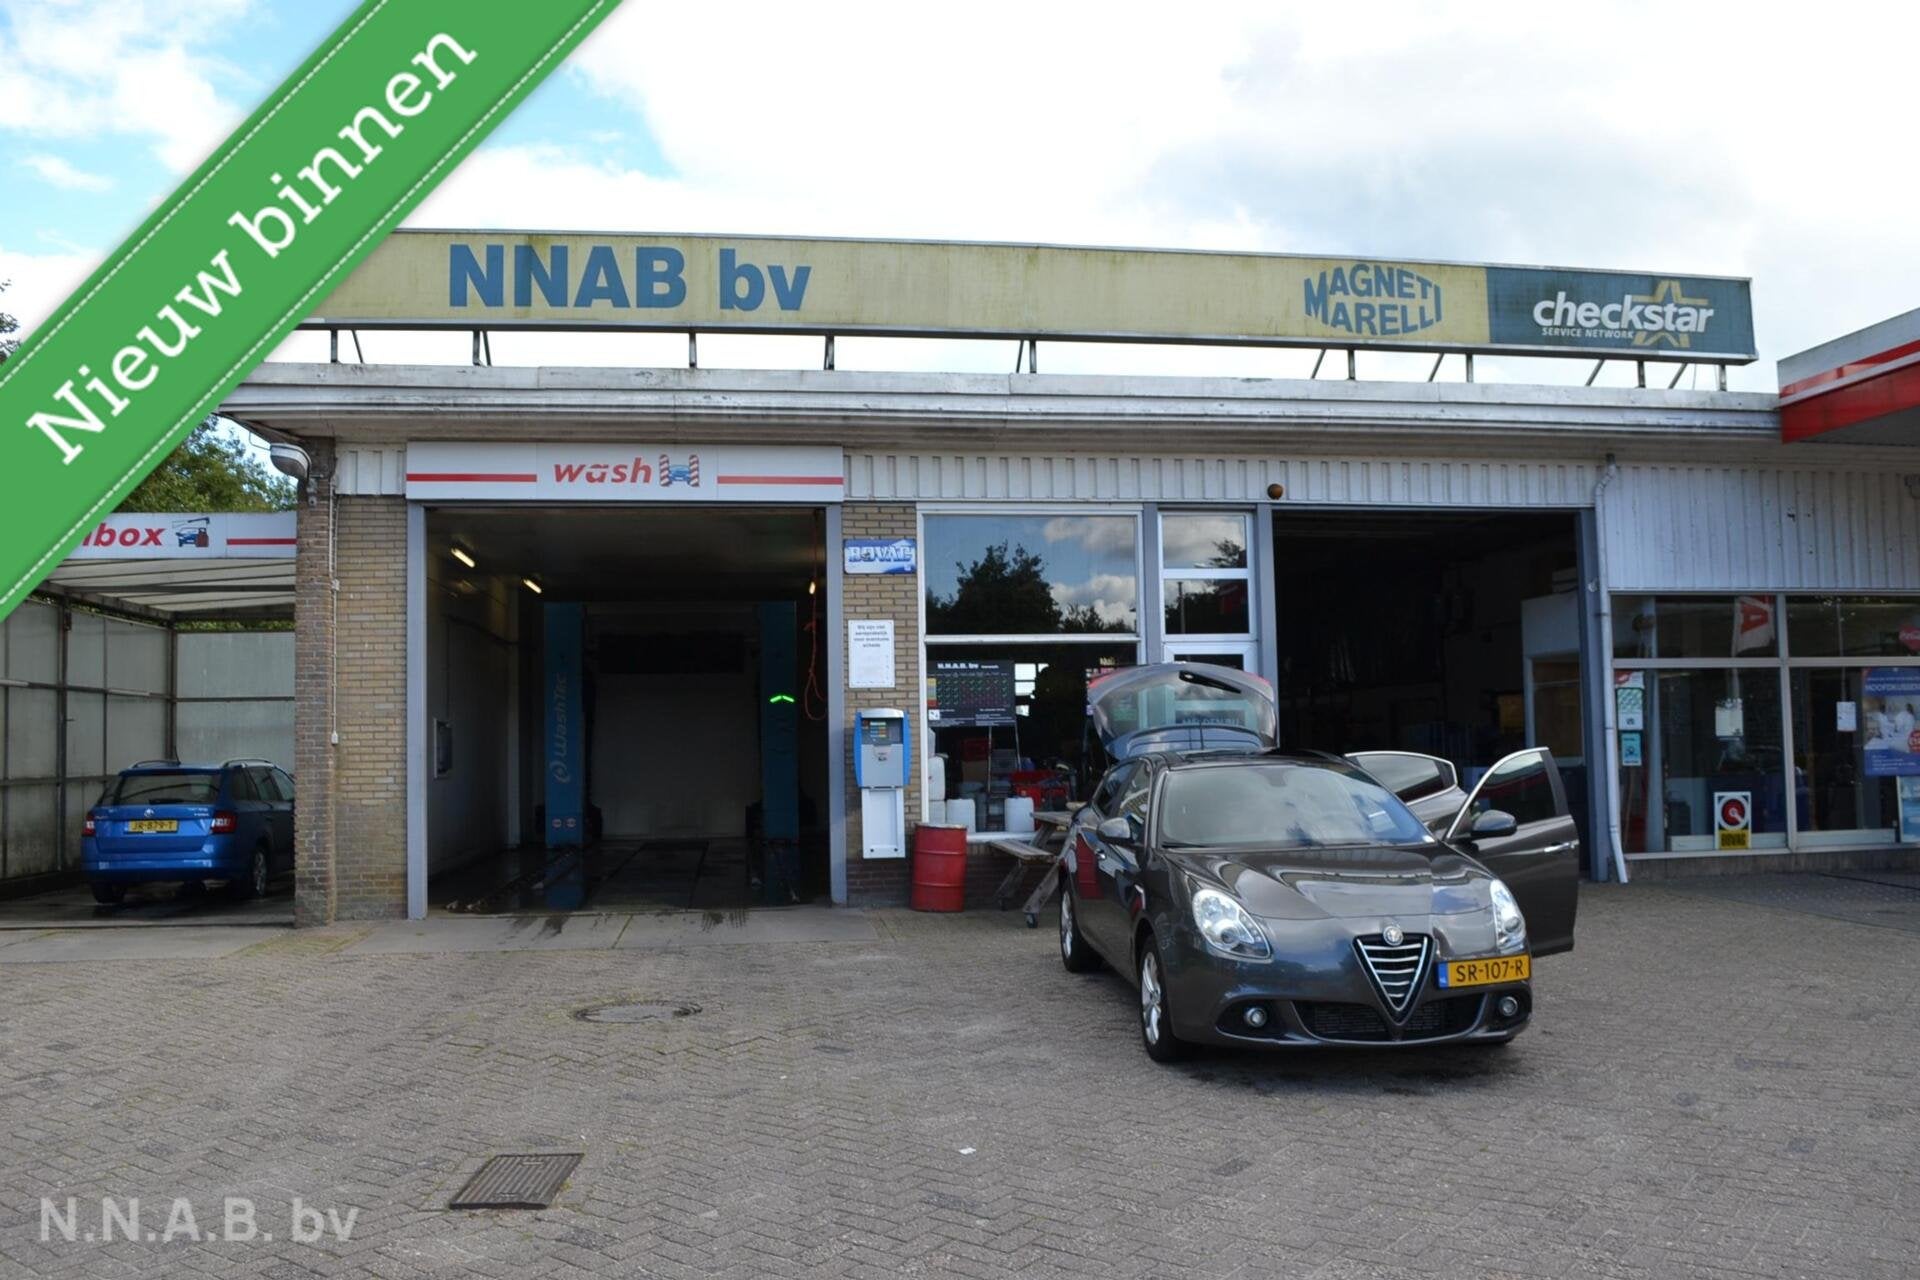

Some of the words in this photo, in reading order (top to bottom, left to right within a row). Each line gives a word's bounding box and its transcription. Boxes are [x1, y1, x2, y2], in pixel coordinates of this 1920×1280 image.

[450, 244, 687, 308] NNAB
[719, 248, 811, 311] bv
[1304, 264, 1442, 312] MAGNETI
[1533, 291, 1714, 332] checkstar
[1541, 327, 1582, 337] SERVICE
[1585, 329, 1634, 339] NETWORK
[554, 457, 652, 484] wash
[1456, 959, 1524, 982] SR-107-R
